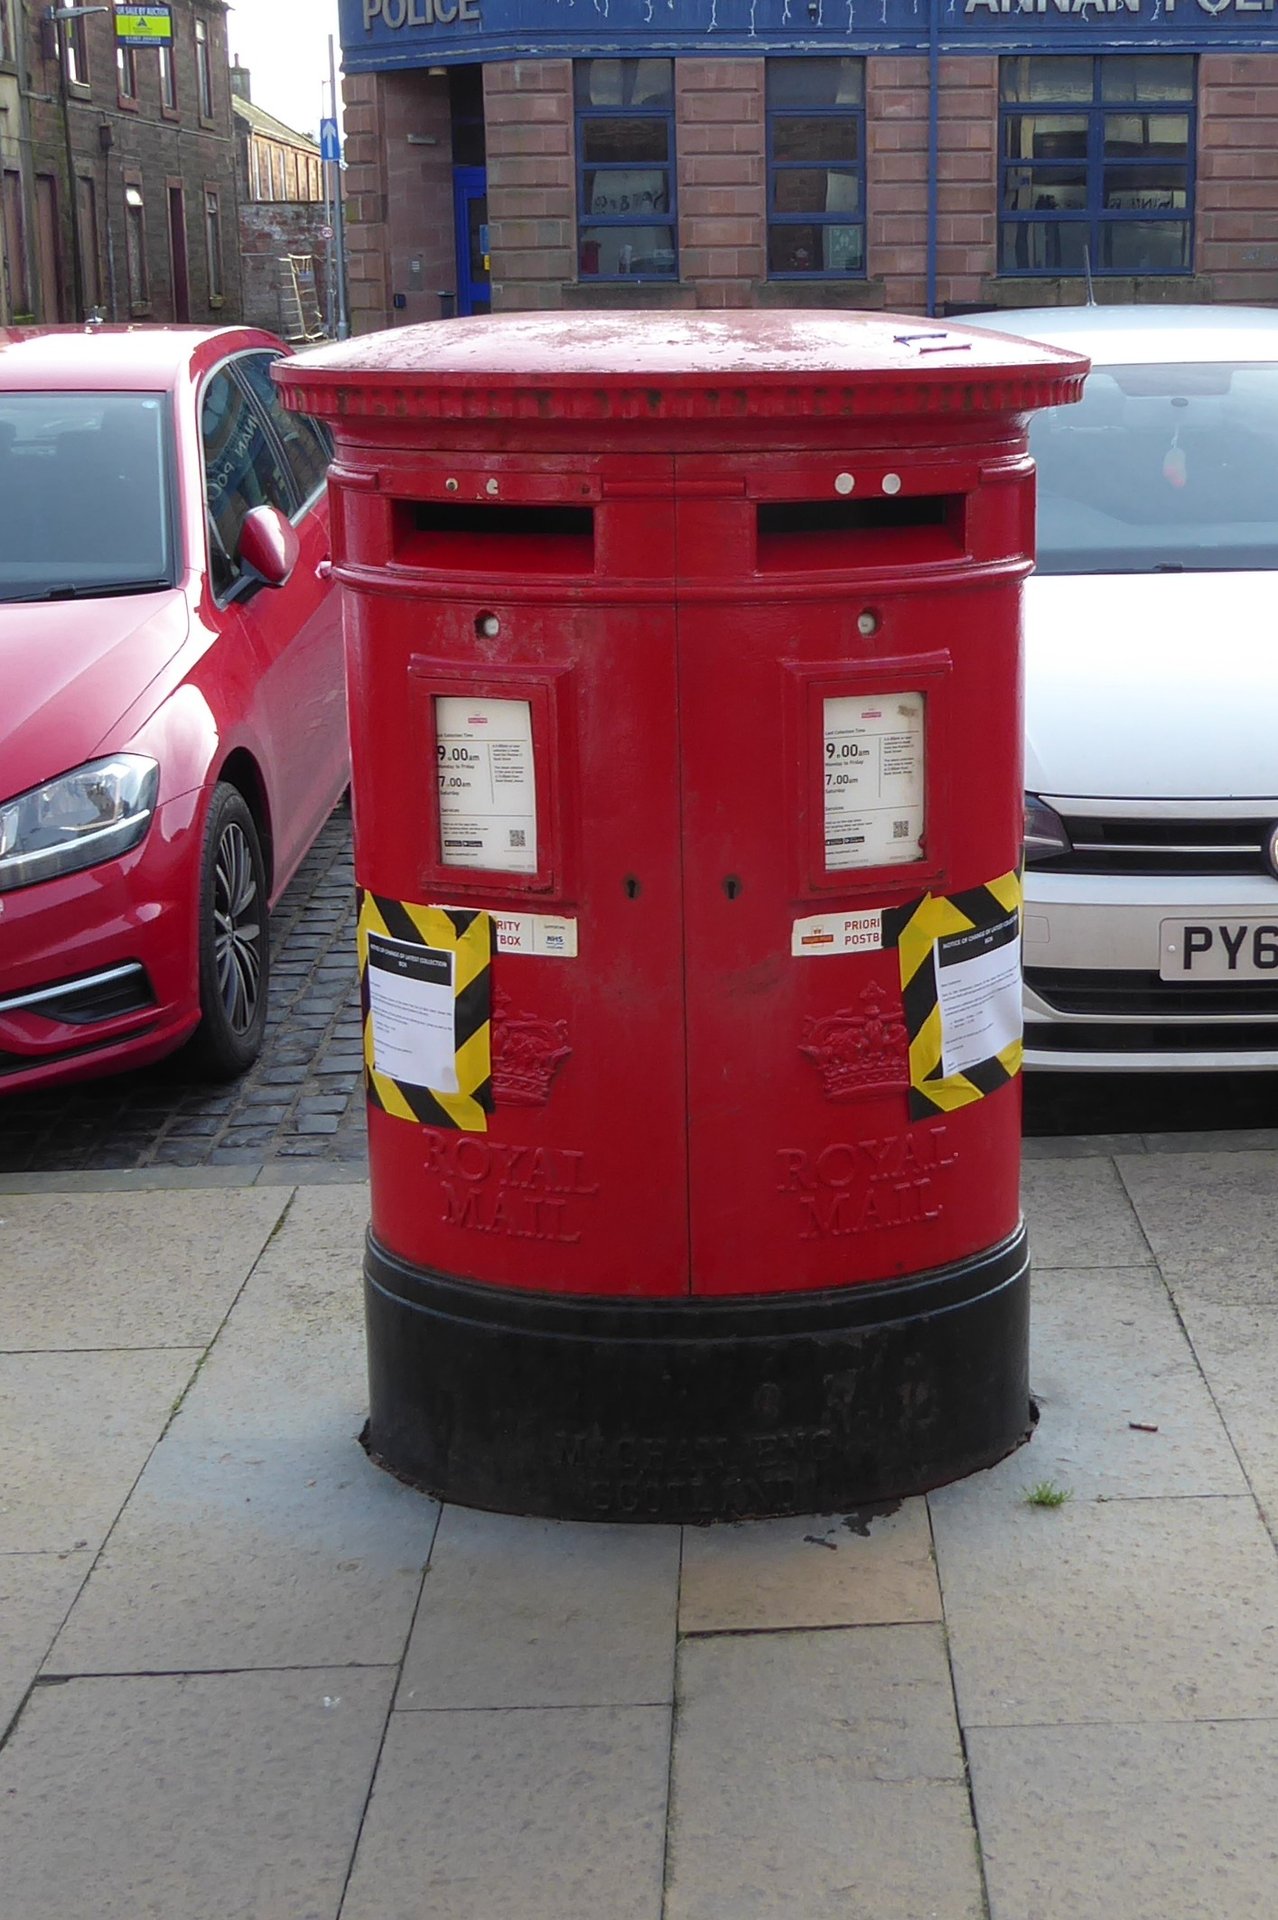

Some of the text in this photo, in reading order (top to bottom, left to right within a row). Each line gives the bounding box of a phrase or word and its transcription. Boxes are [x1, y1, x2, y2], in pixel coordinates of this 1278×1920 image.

[497, 920, 521, 931] RITY
[844, 918, 880, 931] PRIORI
[497, 934, 521, 946] BOX
[547, 935, 564, 943] NHS
[844, 932, 880, 945] POSTB
[422, 1127, 599, 1193] ROYAL
[776, 1125, 959, 1191] ROYAL
[440, 1180, 582, 1242] MAIL
[798, 1177, 943, 1238] MAIL
